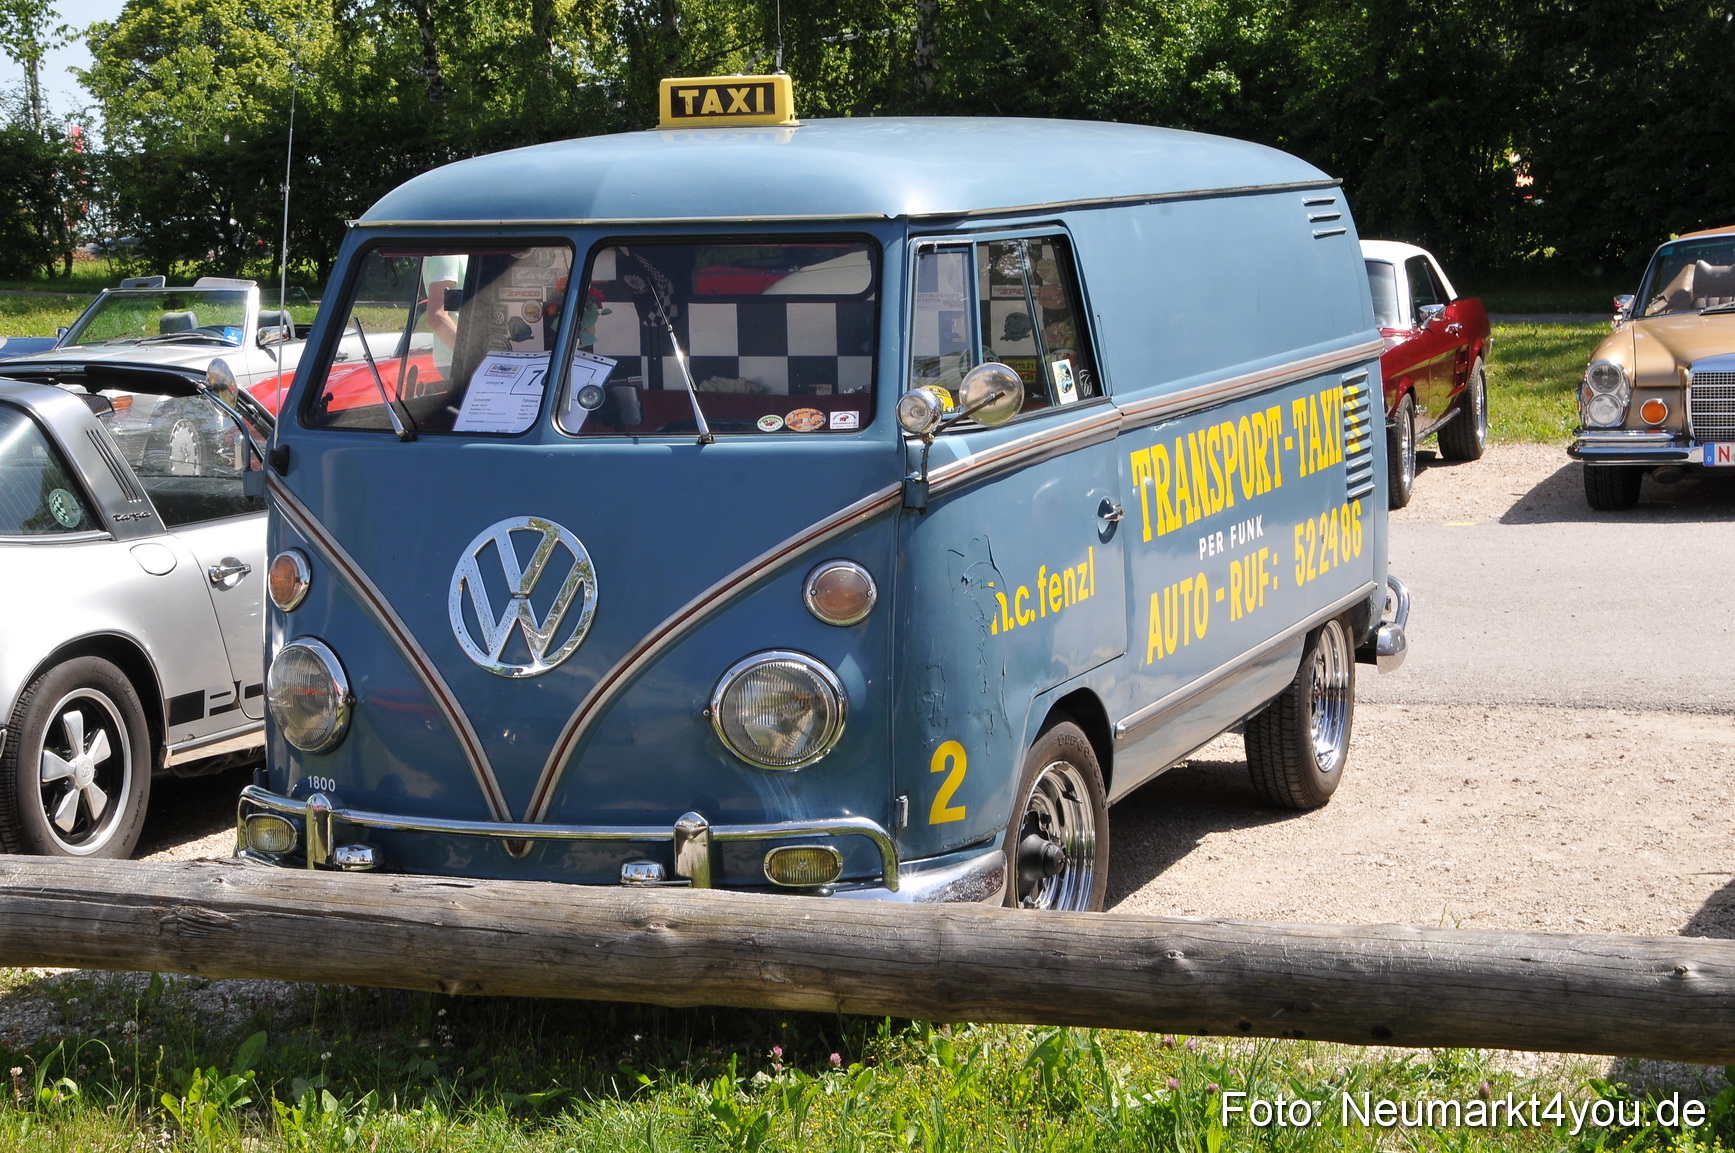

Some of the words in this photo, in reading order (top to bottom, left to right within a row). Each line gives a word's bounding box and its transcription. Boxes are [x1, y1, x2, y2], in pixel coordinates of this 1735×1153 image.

[678, 86, 765, 115] TAXI
[1718, 445, 1731, 463] N
[1198, 530, 1224, 561] PER
[1229, 514, 1265, 549] FUNK
[306, 774, 337, 794] 1800
[928, 739, 968, 826] 2
